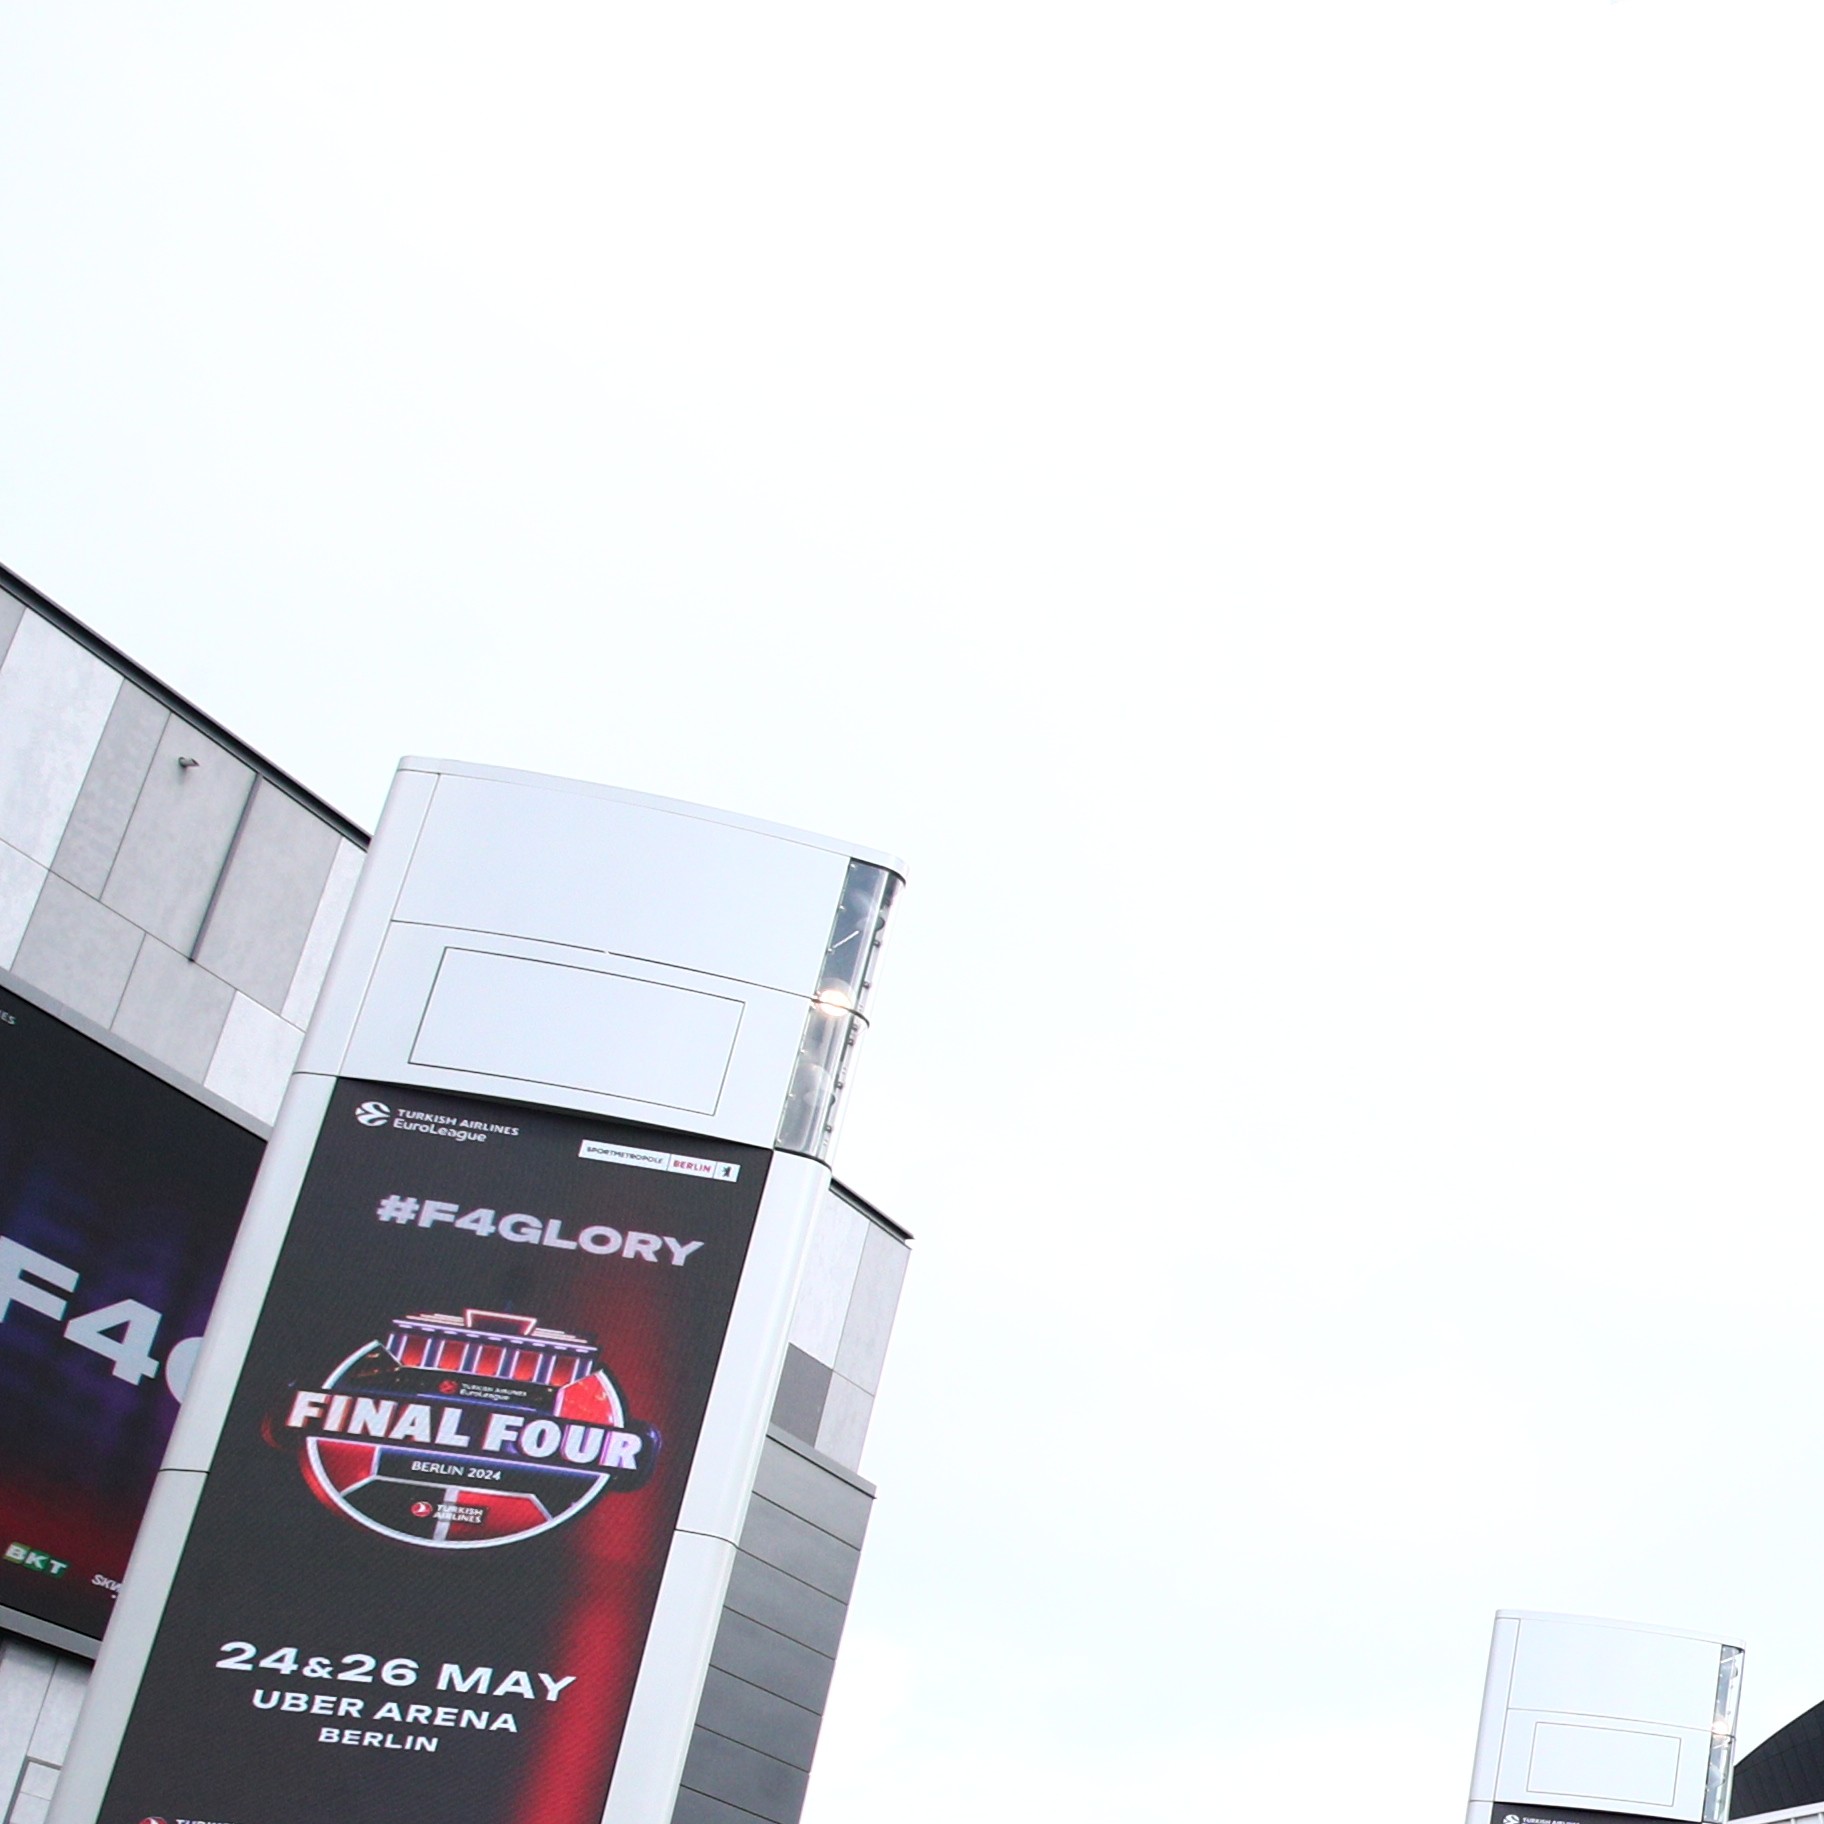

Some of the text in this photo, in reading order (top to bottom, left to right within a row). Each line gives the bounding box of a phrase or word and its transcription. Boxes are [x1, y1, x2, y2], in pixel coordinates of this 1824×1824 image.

[394, 1118, 487, 1143] EuroLeague
[399, 1109, 519, 1136] TURKISH AIRLINES
[672, 1159, 713, 1175] BERLIN
[376, 1194, 705, 1267] #F4GLORY
[286, 1390, 644, 1470] FINAL FOUR
[411, 1460, 501, 1481] BERLIN 2024
[5, 1544, 68, 1574] BKT
[216, 1641, 577, 1702] 24&26 MAY
[252, 1688, 519, 1733] UBER ARENA
[318, 1727, 439, 1752] BERLIN
